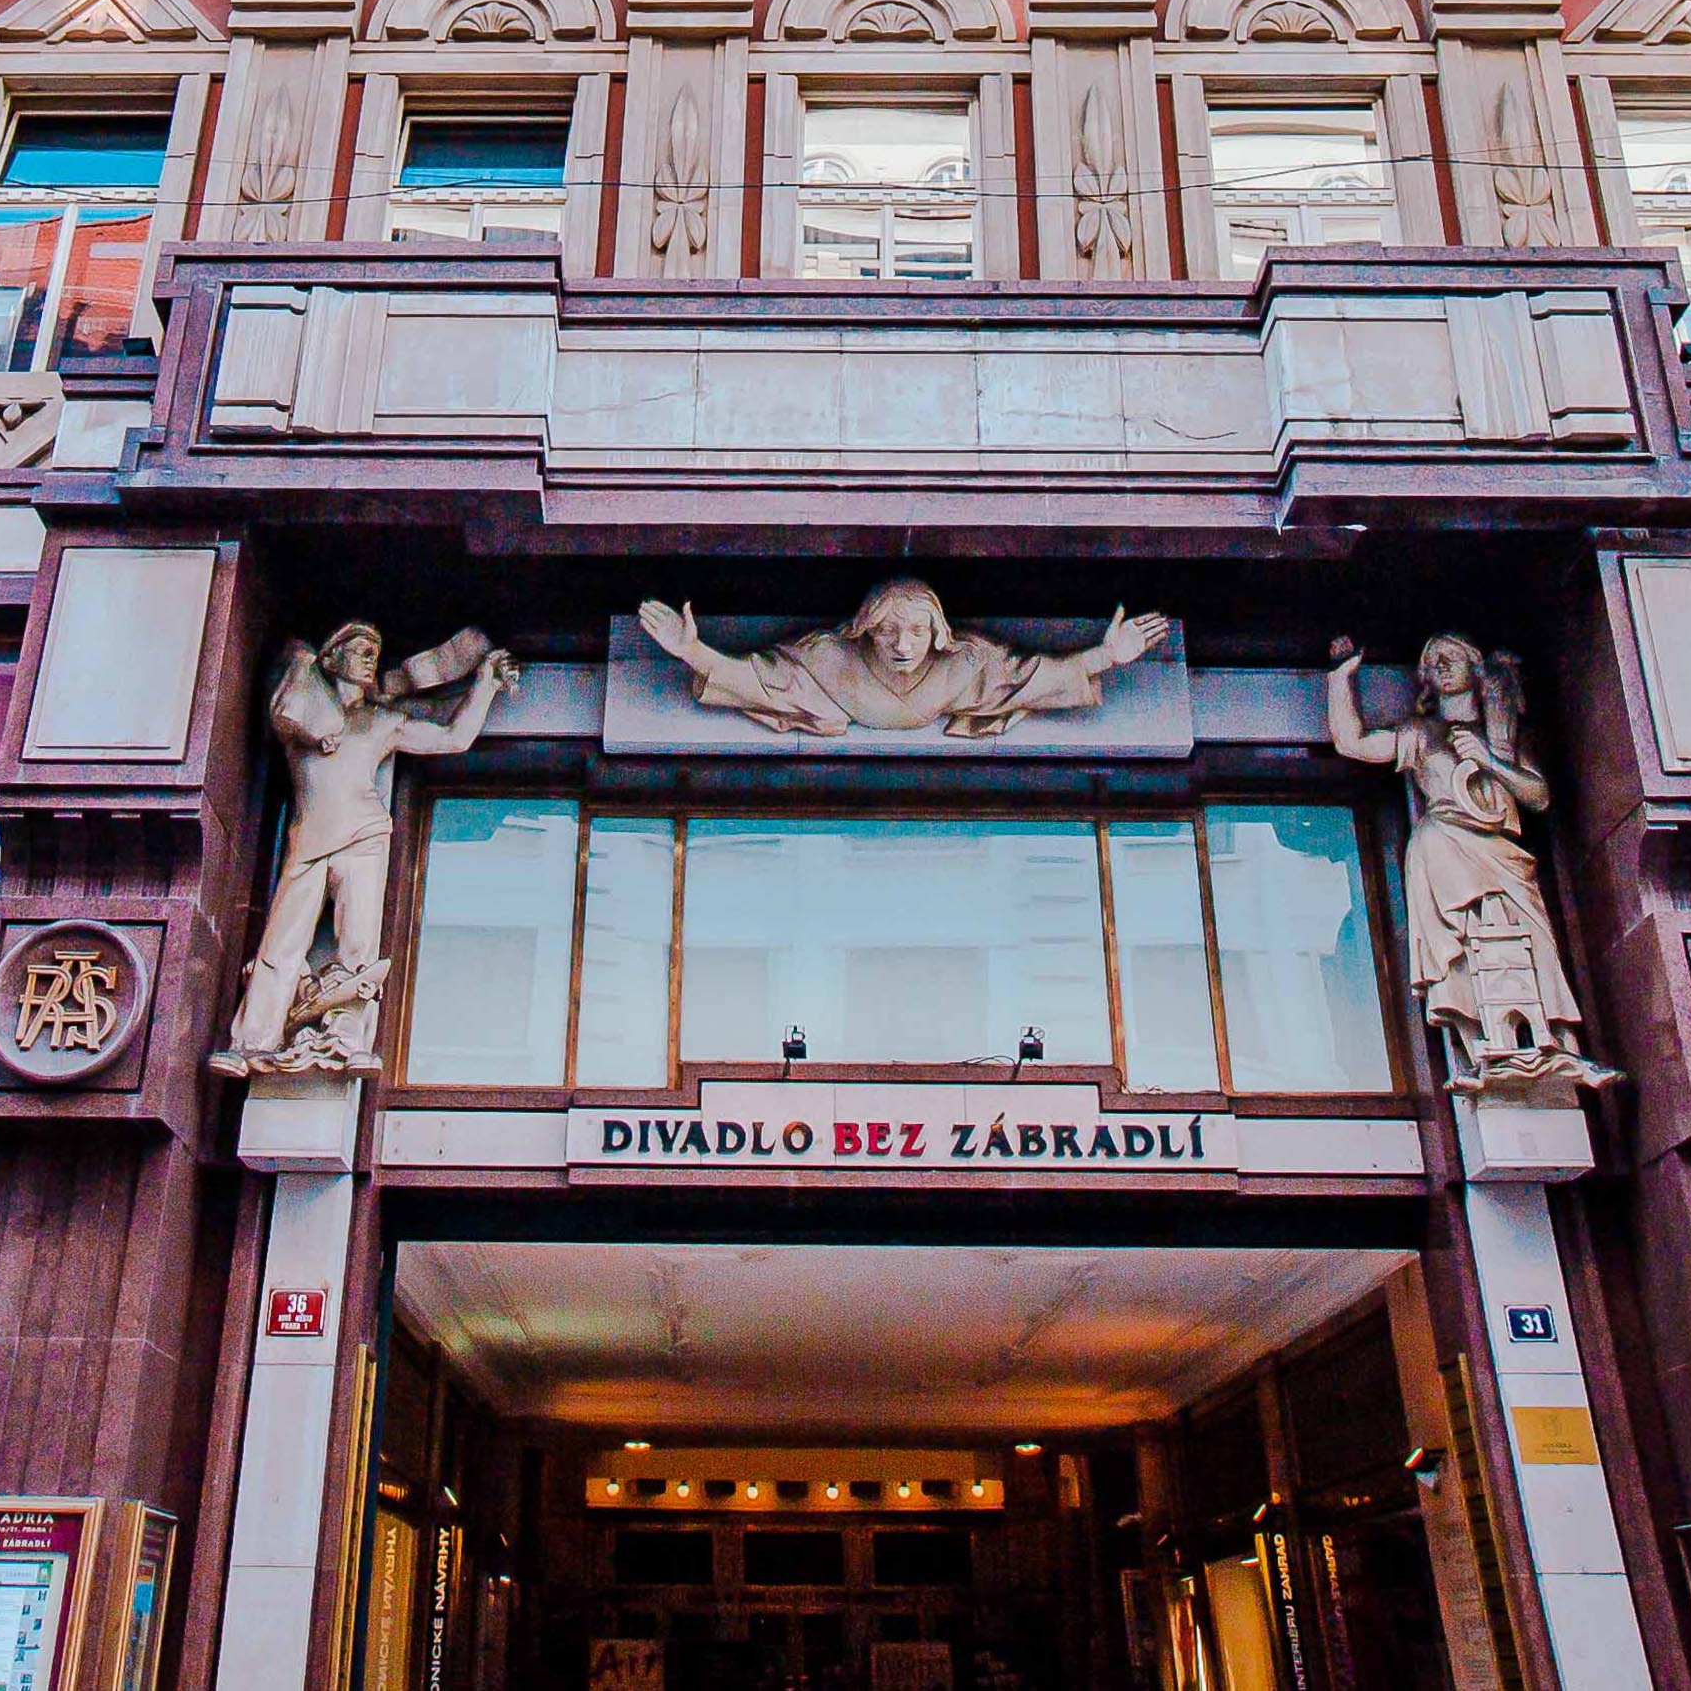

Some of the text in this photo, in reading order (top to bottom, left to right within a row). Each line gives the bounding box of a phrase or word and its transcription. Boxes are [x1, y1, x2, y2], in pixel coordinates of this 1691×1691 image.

[602, 1112, 1205, 1158] DIVADLO BEZ ZÁBRADLÍ
[287, 1293, 308, 1313] 36
[1520, 1314, 1545, 1334] 31
[0, 1511, 54, 1524] ADRIA
